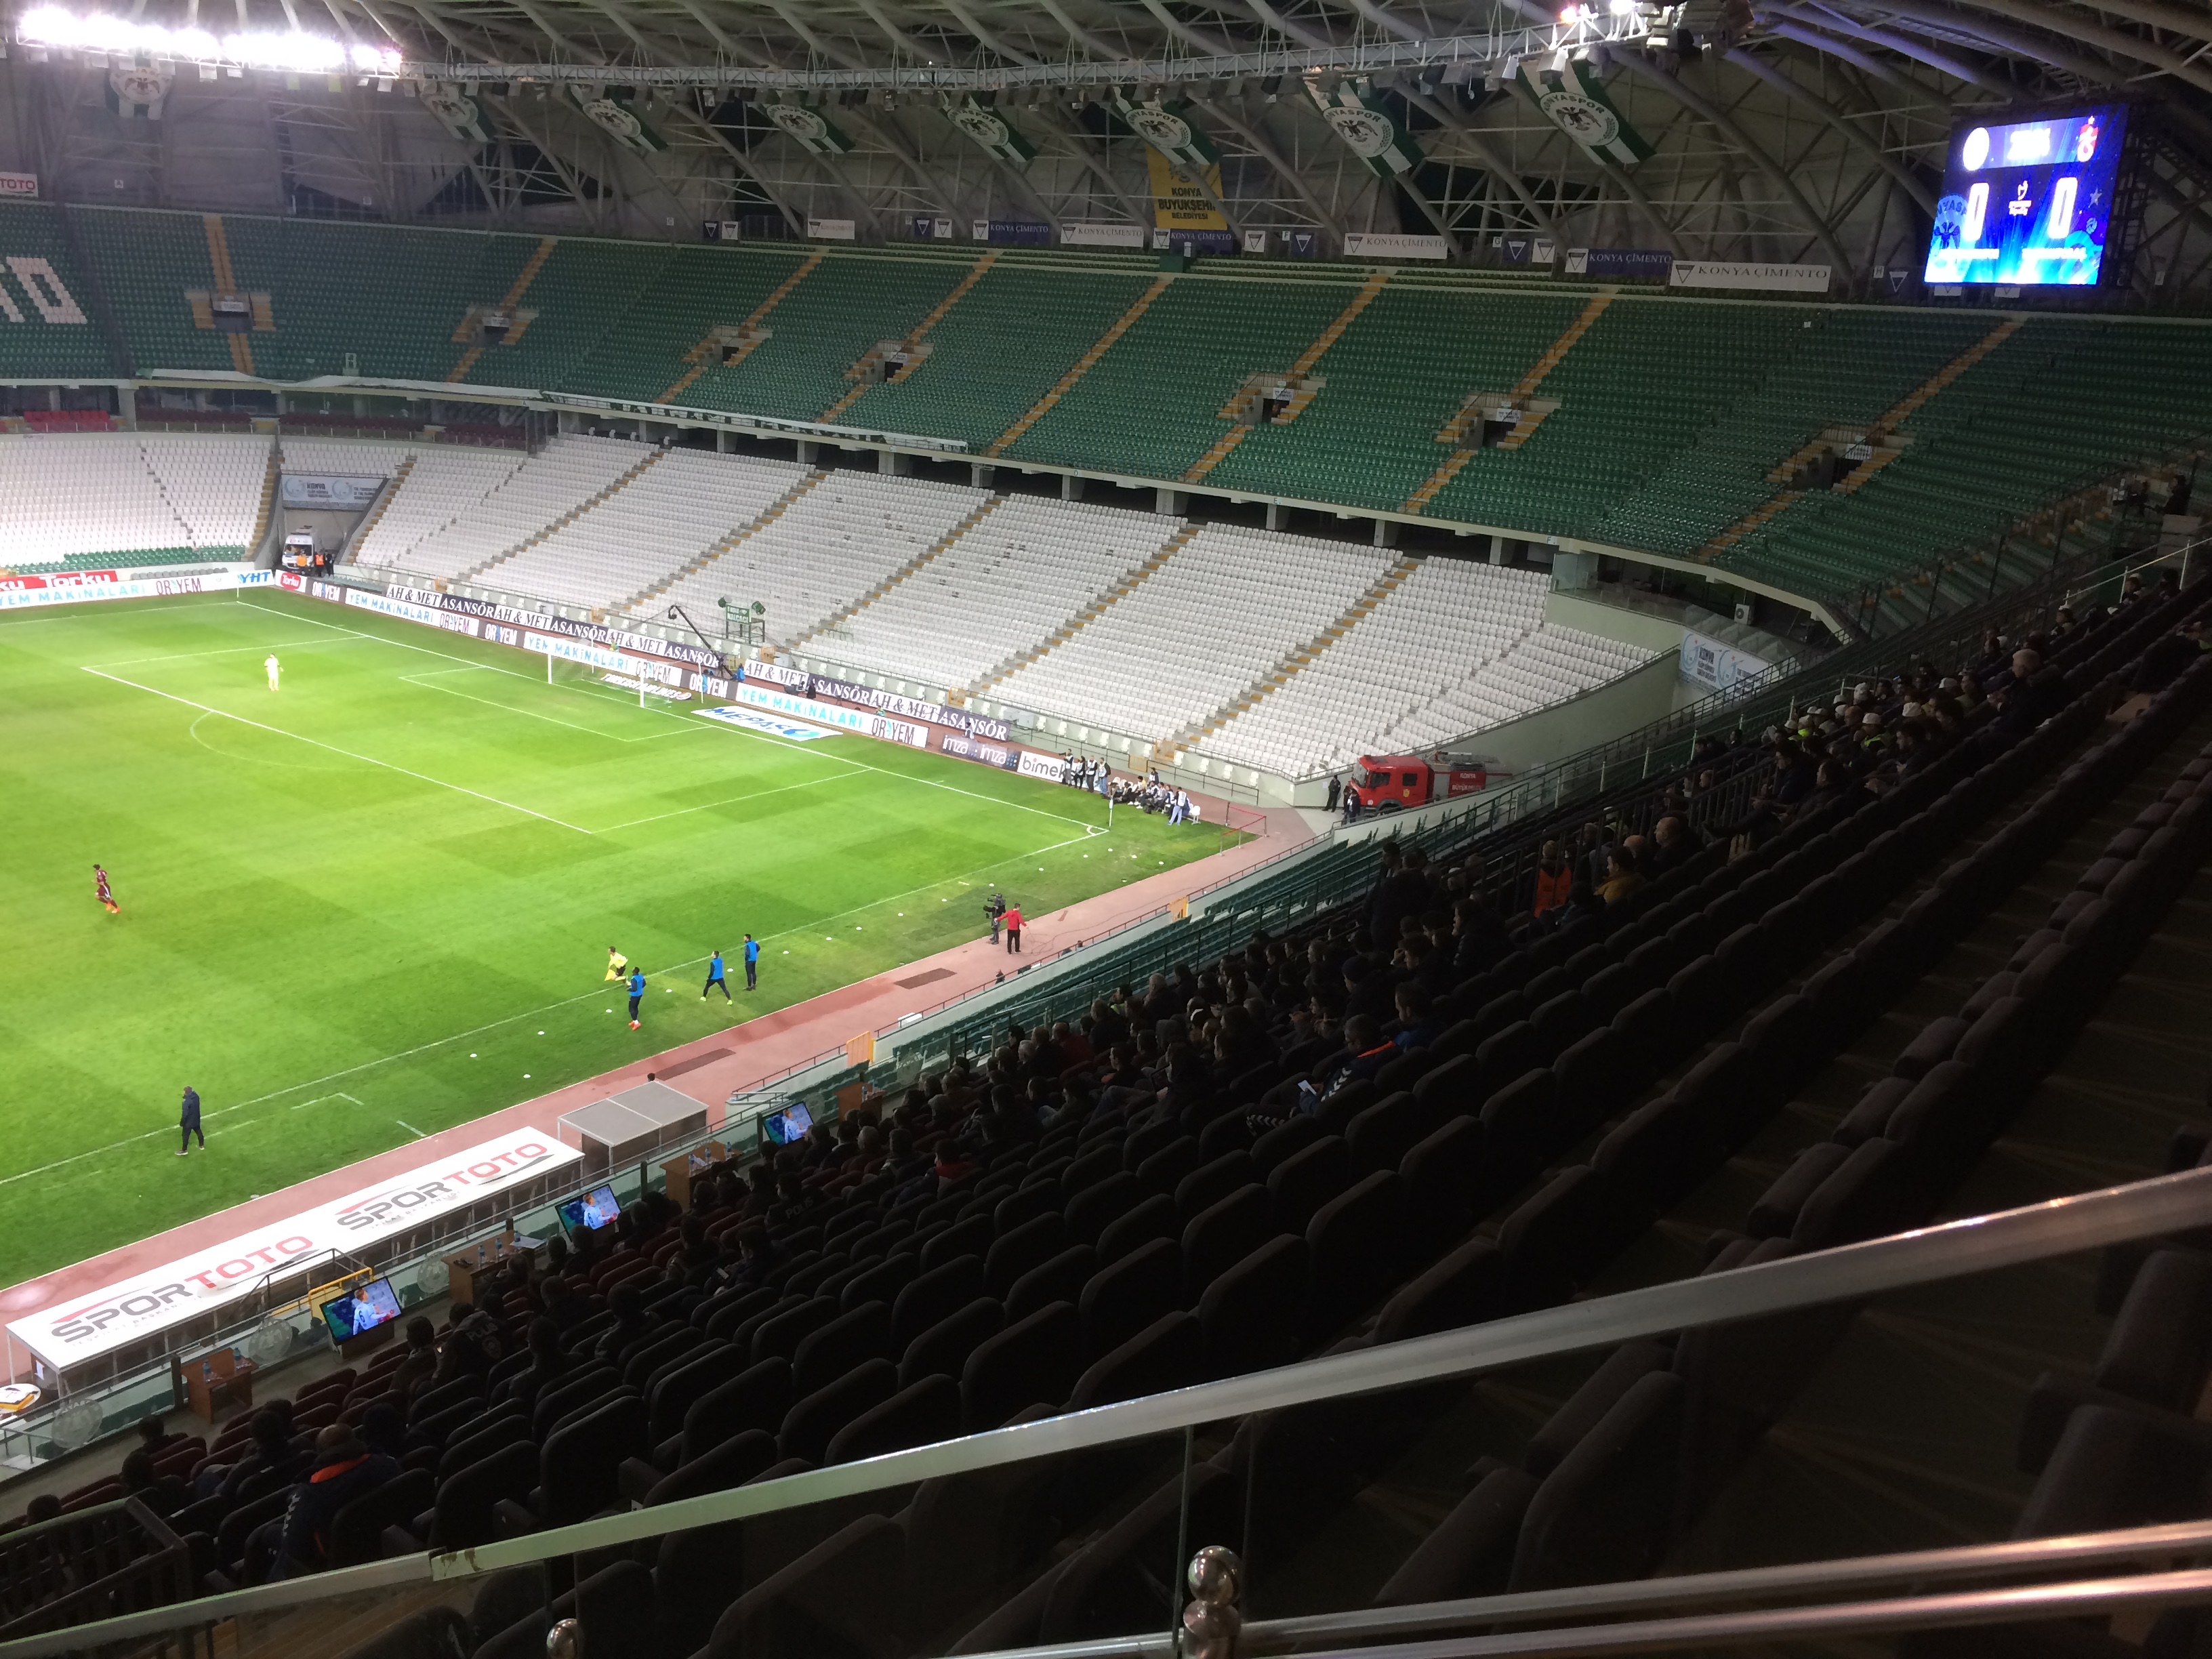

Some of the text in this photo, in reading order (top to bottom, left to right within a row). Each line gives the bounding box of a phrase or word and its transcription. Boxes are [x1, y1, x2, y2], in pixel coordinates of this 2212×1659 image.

[1171, 188, 1202, 197] KONYA
[1965, 177, 2078, 241] 0 0
[1016, 224, 1048, 234] ÇİMENTO
[1078, 227, 1142, 237] KONYA ÇİMENTO
[1170, 231, 1231, 241] KONYA ÇİMENTO
[1366, 237, 1448, 248] KONYA ÇİMENTO
[1589, 253, 1672, 264] KONYA ÇİMENTO
[1698, 266, 1828, 279] KONYA ÇİMENTO
[38, 571, 111, 588] Torku
[282, 573, 300, 587] Torku
[349, 593, 368, 606] YEM
[388, 586, 440, 607] AH & MET
[441, 596, 495, 617] ASANSÖR
[495, 608, 551, 630] AH & MET
[550, 619, 609, 642] ASANSÖR
[626, 634, 635, 647] &
[635, 636, 663, 654] MET
[746, 663, 762, 678] AH
[765, 666, 775, 679] &
[741, 688, 768, 705] YEM
[869, 694, 940, 720] AH & MET
[937, 711, 1008, 741] ASANSÖR
[943, 735, 1008, 764] imza imza
